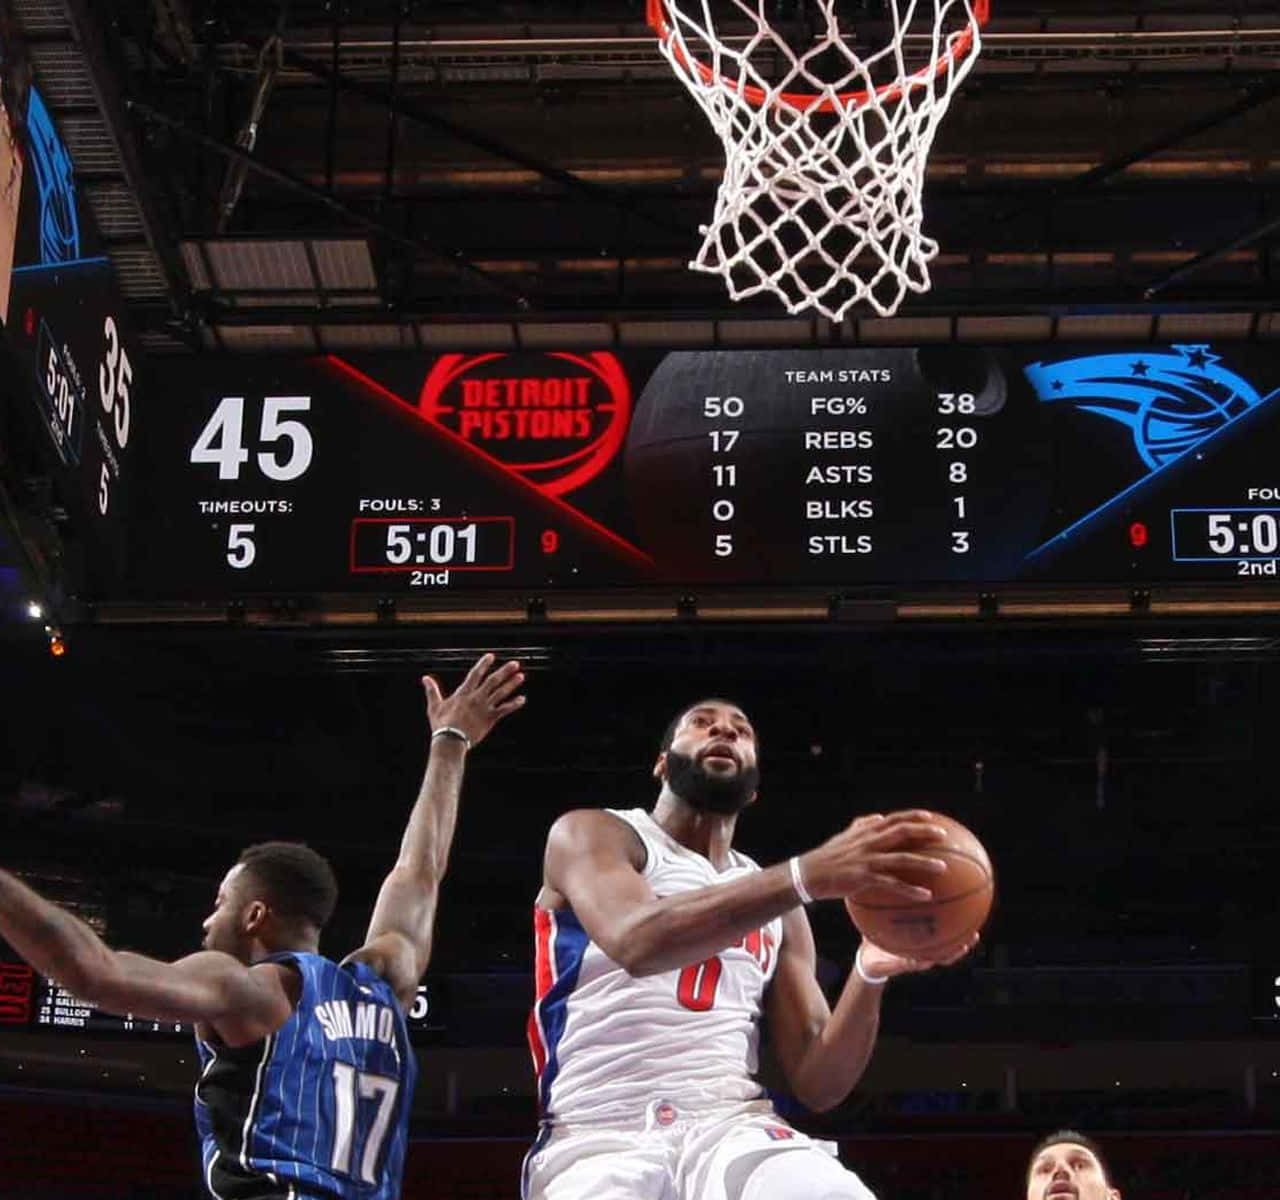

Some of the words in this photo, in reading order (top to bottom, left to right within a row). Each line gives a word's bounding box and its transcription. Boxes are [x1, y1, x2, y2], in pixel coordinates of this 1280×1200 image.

[99, 315, 133, 448] 35
[785, 370, 834, 383] TEAM
[840, 368, 891, 382] STATS
[47, 347, 74, 437] 5:01
[462, 377, 590, 410] DETROIT
[703, 396, 744, 418] 50
[811, 395, 867, 416] FG%
[937, 393, 976, 416] 38
[460, 408, 592, 438] PISTONS
[190, 396, 314, 482] 45
[709, 431, 739, 452] 17
[805, 430, 873, 451] REBS
[936, 427, 977, 450] 20
[713, 466, 737, 486] 11
[805, 465, 873, 485] ASTS
[949, 462, 968, 484] 8
[99, 462, 109, 515] 5
[199, 500, 294, 514] TIMEOUTS:
[359, 498, 426, 512] FOULS:
[431, 498, 441, 511] 3
[713, 499, 735, 522] 0
[806, 500, 873, 519] BLKS
[953, 497, 965, 518] 1
[227, 524, 255, 569] 5
[386, 524, 478, 565] 5:01
[540, 533, 558, 554] 9
[714, 535, 733, 556] 5
[808, 535, 873, 554] STLS
[951, 532, 970, 554] 3
[1129, 523, 1147, 546] 9
[410, 570, 449, 586] 2nd
[1238, 560, 1277, 576] 2nd
[676, 956, 722, 1012] 0
[409, 985, 429, 1019] 5
[314, 999, 396, 1047] SIMMO
[331, 1060, 400, 1185] 17
